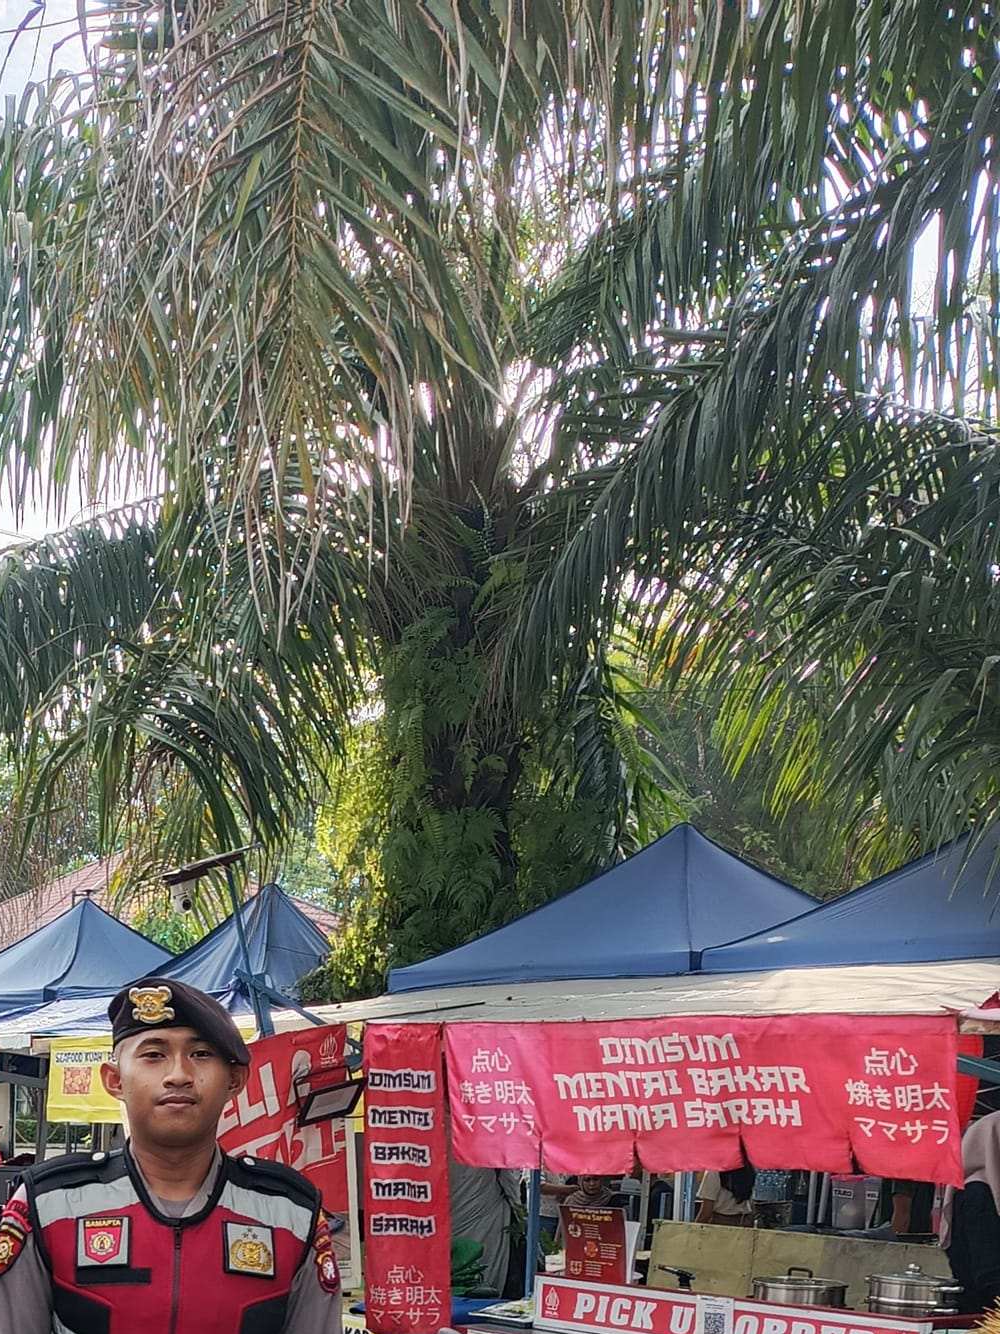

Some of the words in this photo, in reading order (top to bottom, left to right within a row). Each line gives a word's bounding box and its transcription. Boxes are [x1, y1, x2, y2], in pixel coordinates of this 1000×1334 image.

[55, 1052, 83, 1063] SEAFOOD
[599, 1033, 741, 1065] DIMSUM
[470, 1048, 512, 1074] 点心
[864, 1047, 919, 1077] 点心
[368, 1070, 432, 1090] DIMSUM
[553, 1069, 683, 1099] MENTAI
[687, 1065, 811, 1096] BAKAR
[216, 1062, 281, 1140] ELI
[459, 1080, 536, 1105] 焼き明太
[844, 1078, 951, 1112] 焼き明太
[370, 1108, 431, 1127] MENTAI
[461, 1113, 535, 1136] ママサラ
[573, 1102, 678, 1132] MAMA
[683, 1098, 802, 1128] SARAH
[853, 1116, 950, 1145] ママサラ
[373, 1145, 428, 1164] BAKAR
[374, 1181, 429, 1200] MAMA
[833, 1189, 853, 1198] TARO
[372, 1215, 433, 1236] SARAH
[386, 1264, 425, 1285] 点心
[369, 1284, 443, 1306] 焼き明太
[370, 1307, 442, 1326] ママサラ
[573, 1292, 657, 1330] PICK
